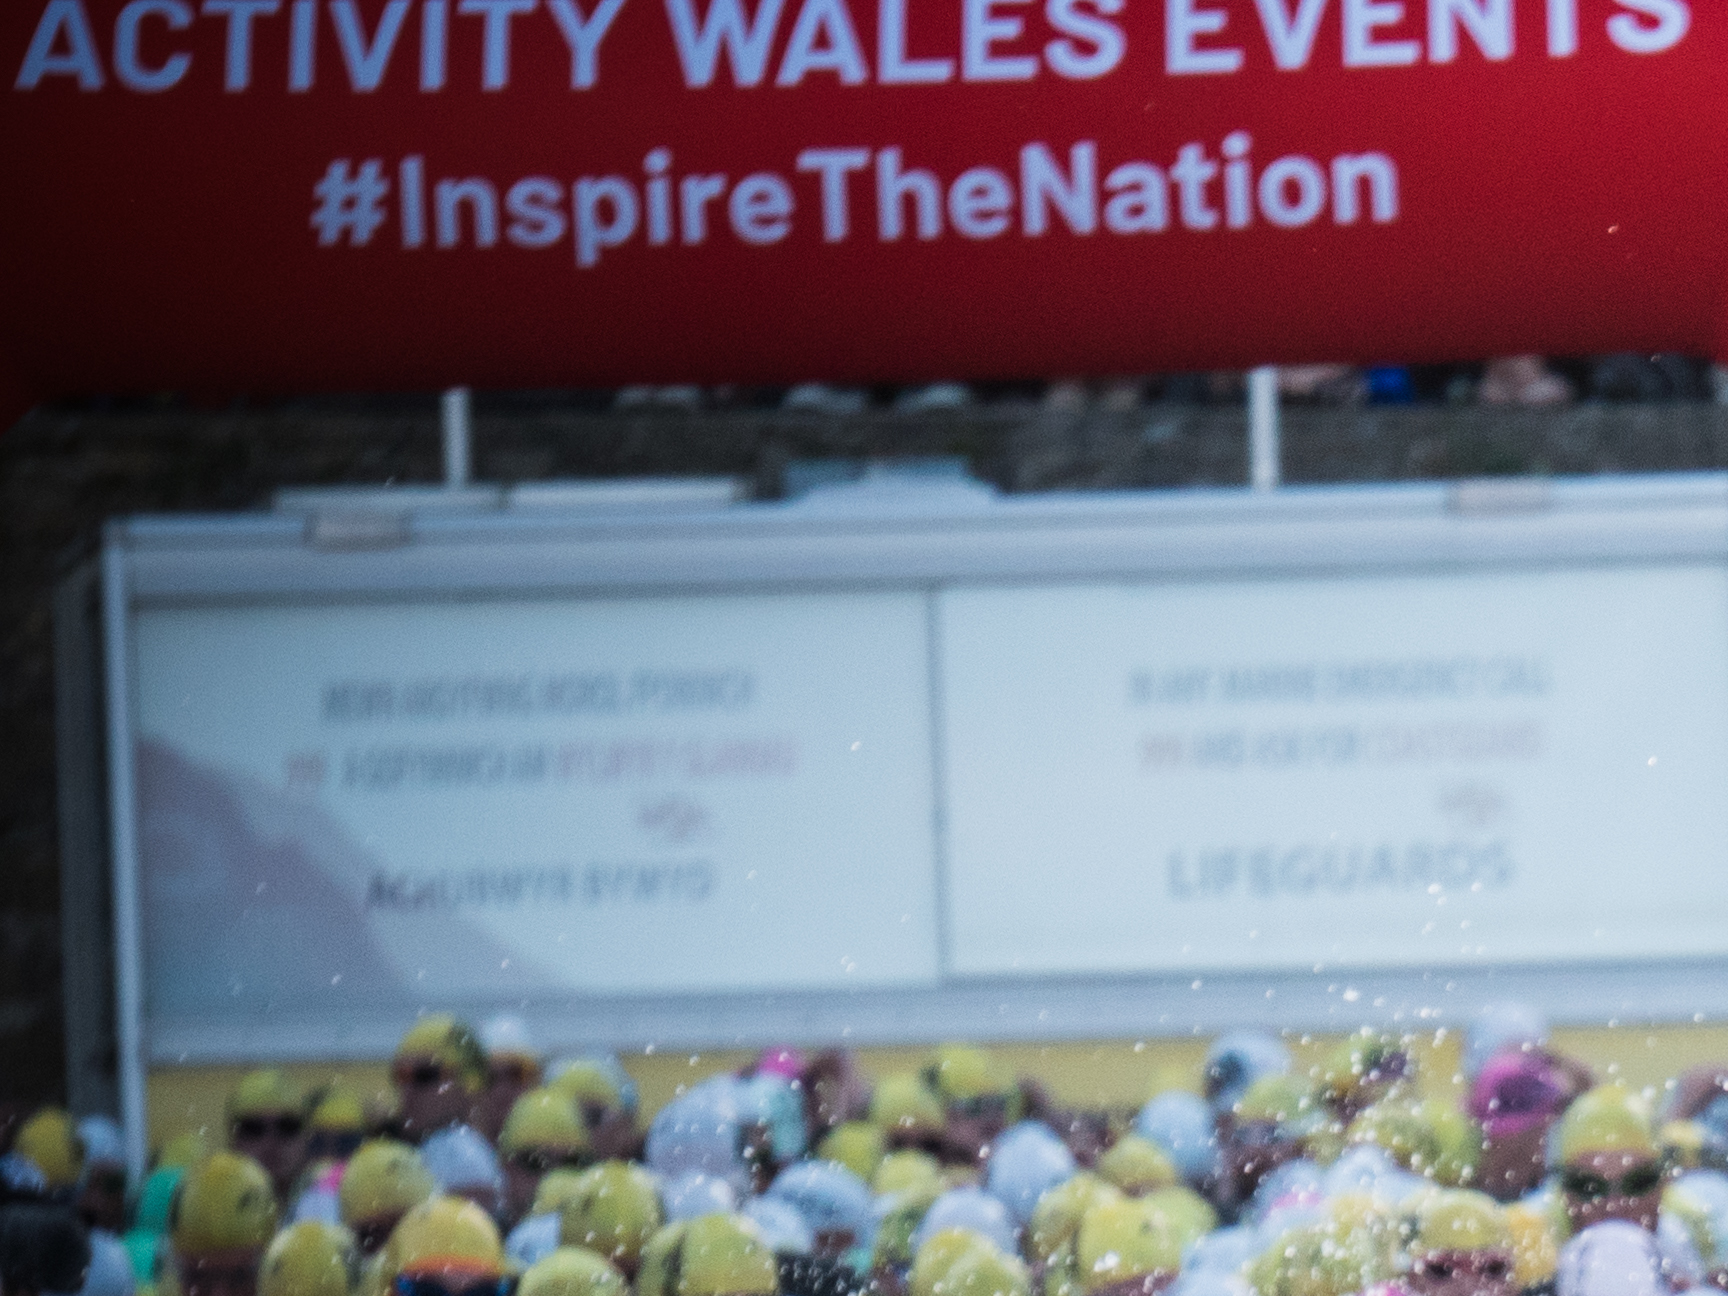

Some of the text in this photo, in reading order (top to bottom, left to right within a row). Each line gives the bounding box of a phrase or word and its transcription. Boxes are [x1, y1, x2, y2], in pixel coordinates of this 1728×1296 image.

[14, 0, 1692, 93] ACTIVITY WALES EVENTS
[310, 130, 1398, 269] #InspireTheNation
